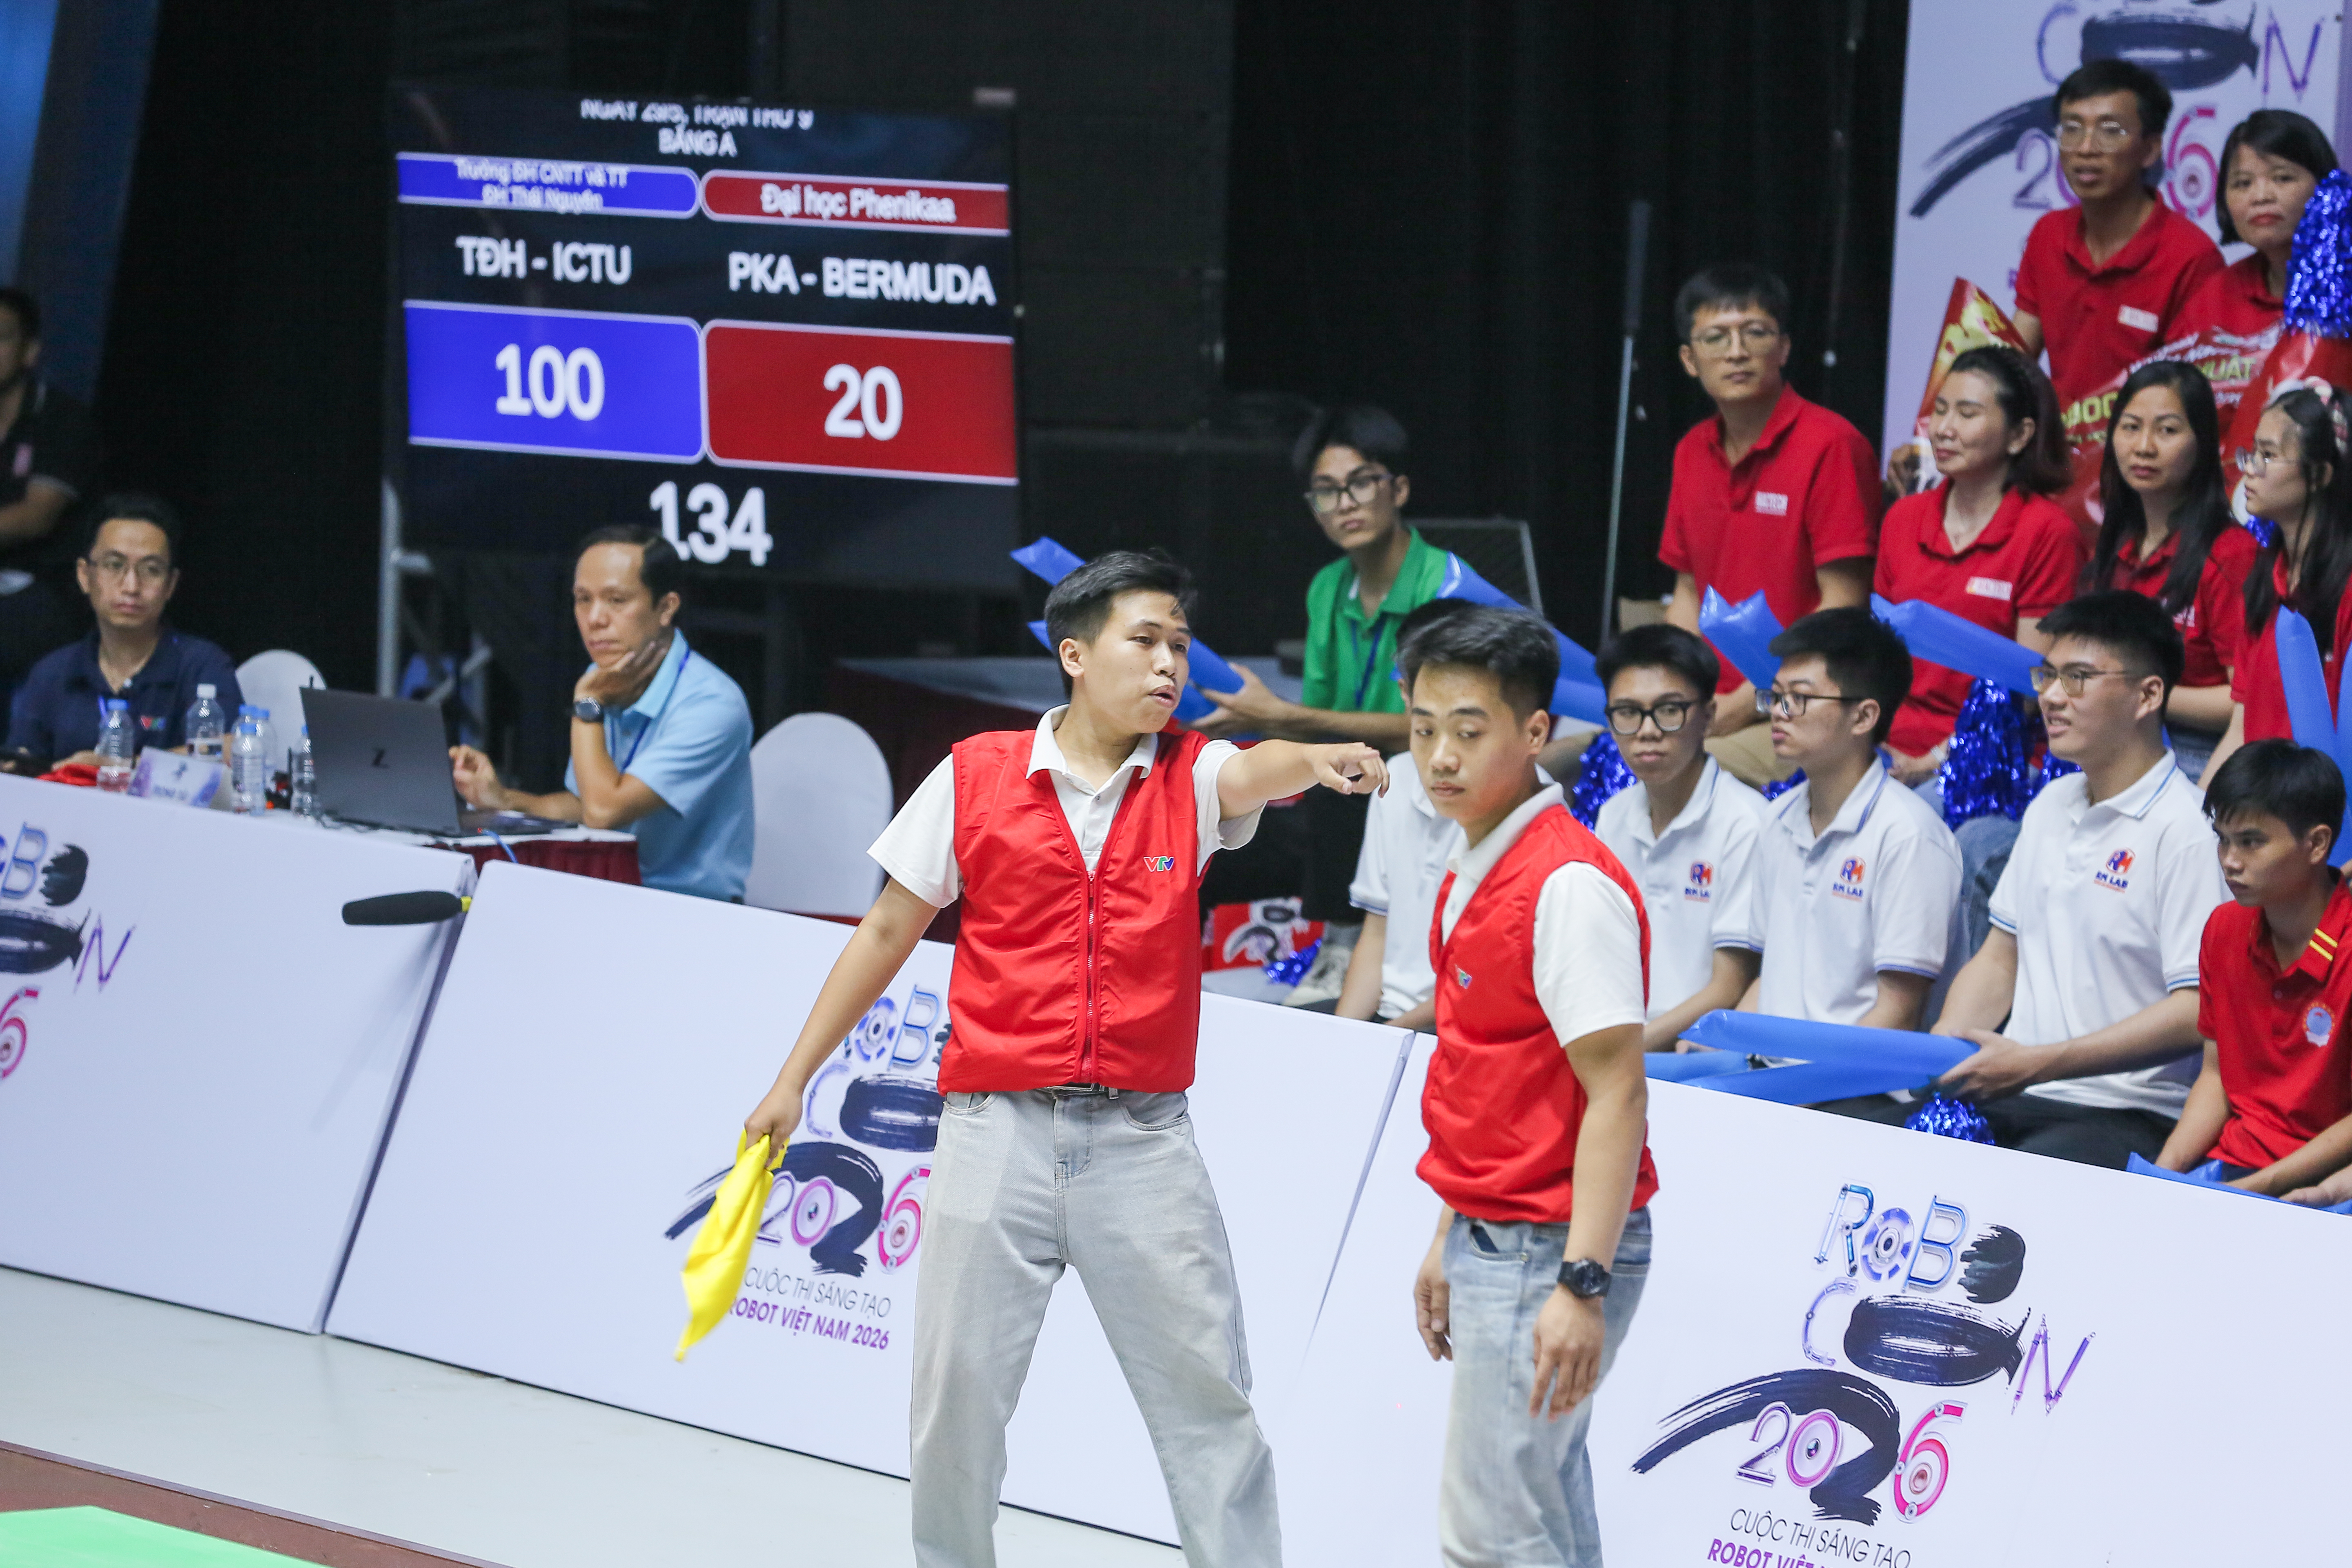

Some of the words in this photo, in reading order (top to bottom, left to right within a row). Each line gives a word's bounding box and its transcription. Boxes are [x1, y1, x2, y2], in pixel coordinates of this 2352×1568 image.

[719, 130, 737, 158] A
[607, 165, 629, 188] TT
[760, 183, 801, 218] Đại
[804, 184, 848, 220] học
[849, 187, 957, 223] Phenikaa
[455, 235, 527, 279] TĐH
[552, 241, 632, 285] ICTU
[728, 251, 801, 295] PKA
[822, 256, 997, 306] BERMUDA
[495, 343, 606, 421] 100
[823, 363, 903, 441] 20
[1143, 855, 1174, 872] VTV
[744, 1267, 791, 1296] CUỘC
[793, 1277, 815, 1300] THI
[815, 1281, 858, 1310] SÁNG
[860, 1293, 891, 1320] TẠO
[781, 1305, 813, 1337] VIỆT
[812, 1315, 851, 1342] NAM
[851, 1323, 891, 1350] 2026
[1707, 1538, 1774, 1568] ROBOT
[1731, 1508, 1788, 1543] CUỘC
[1790, 1522, 1817, 1549] THI
[1816, 1528, 1870, 1562] SÁNG
